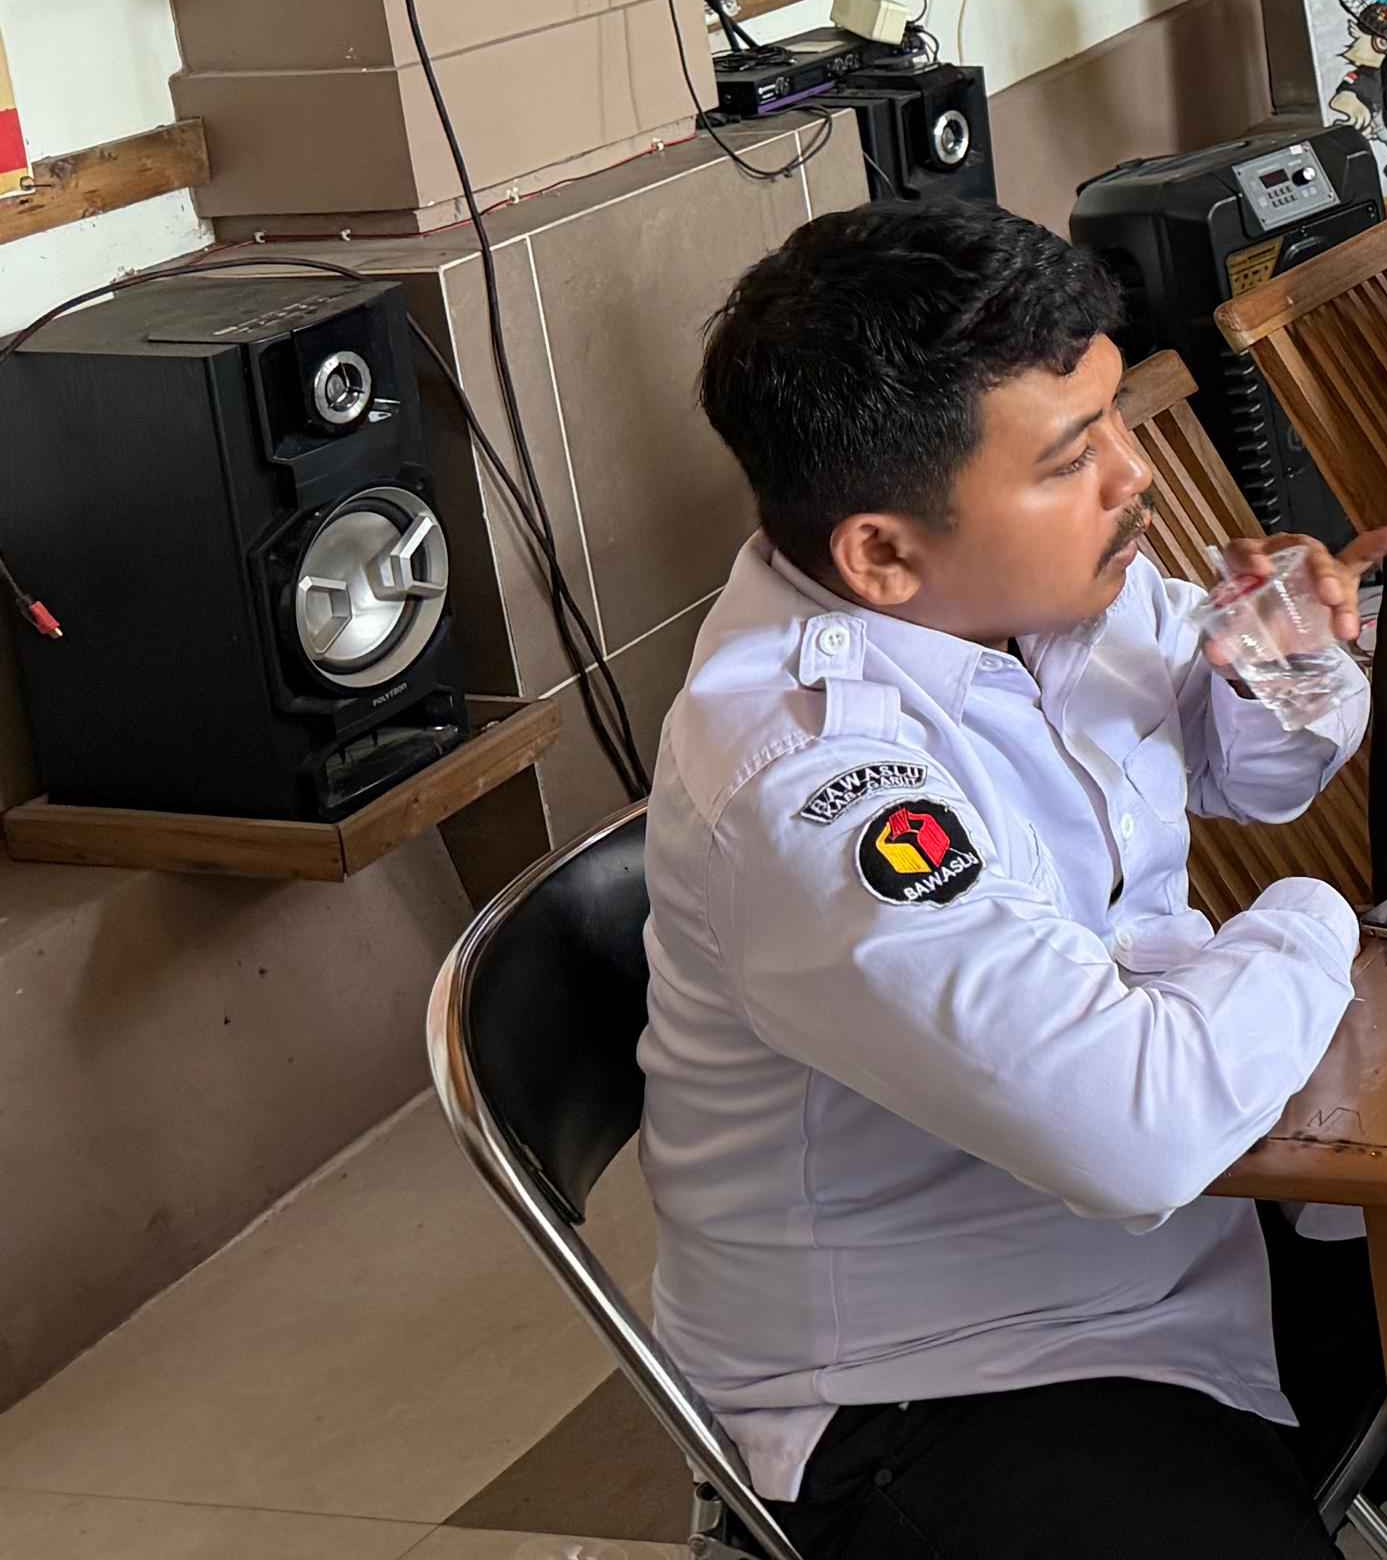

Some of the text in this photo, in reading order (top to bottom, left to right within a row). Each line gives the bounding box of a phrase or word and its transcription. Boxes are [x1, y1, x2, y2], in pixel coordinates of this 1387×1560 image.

[812, 765, 919, 815] BAWASLU
[867, 776, 918, 790] GARUT
[903, 850, 979, 901] BAWASLU
